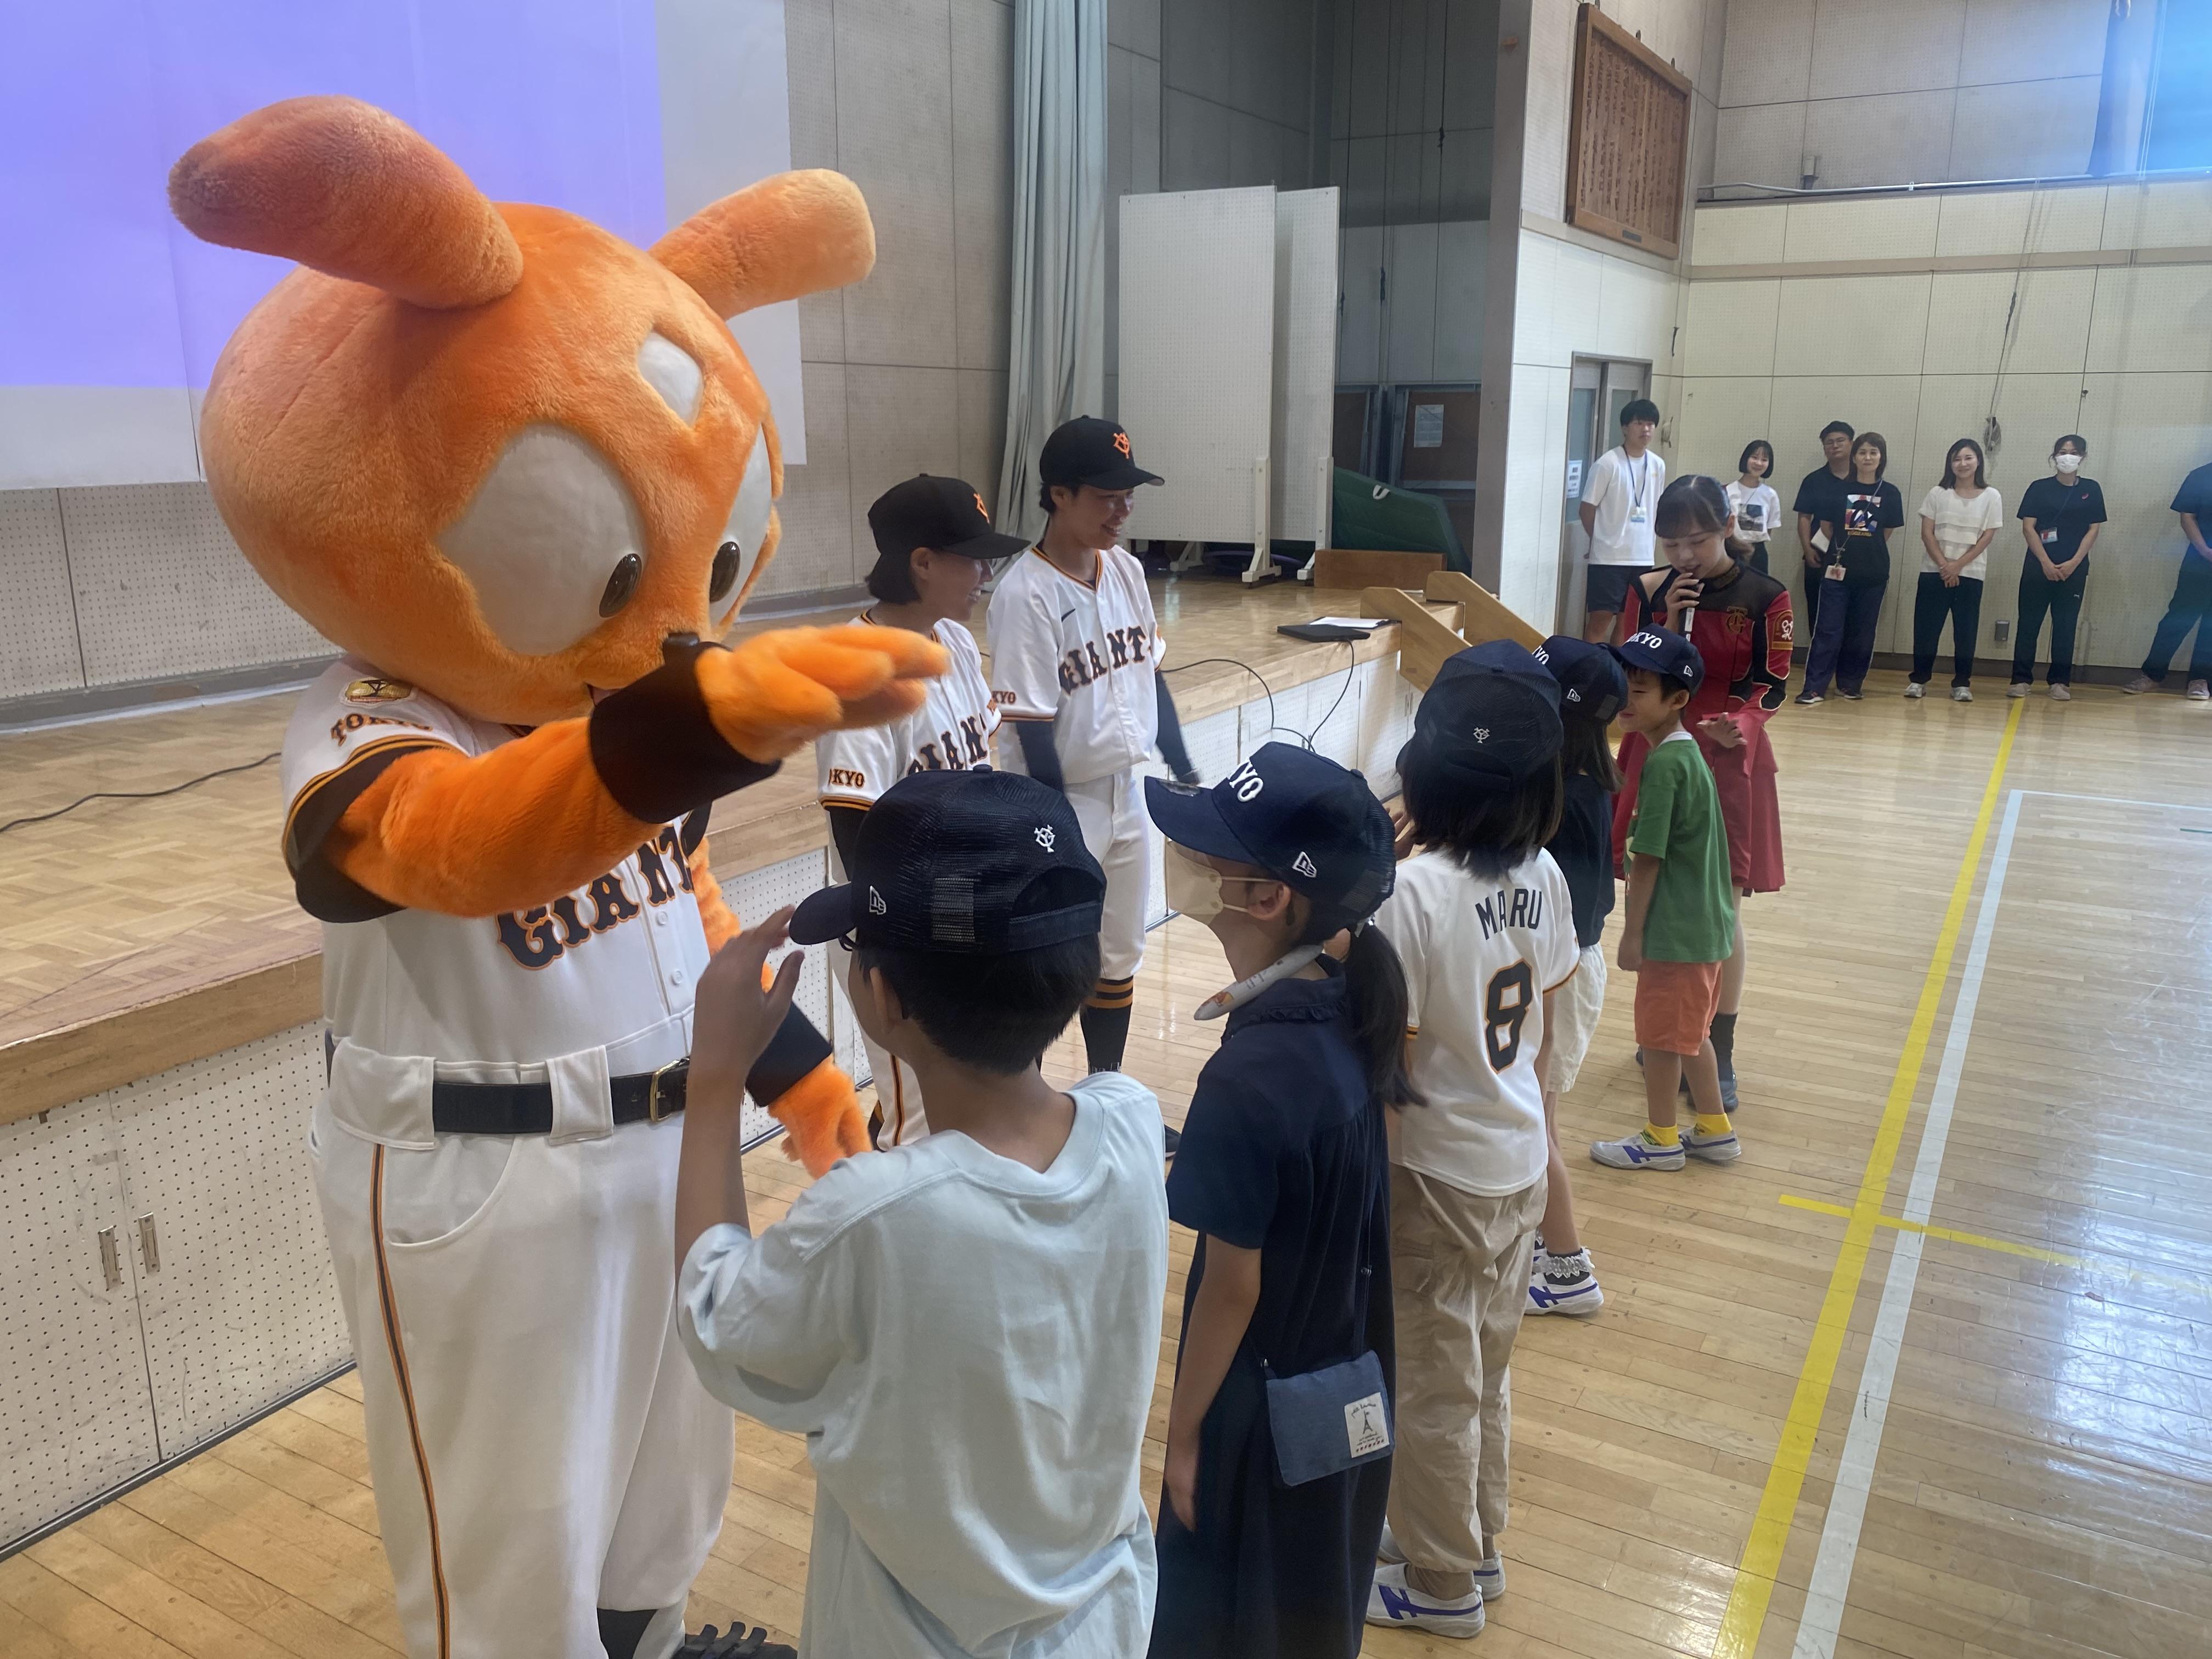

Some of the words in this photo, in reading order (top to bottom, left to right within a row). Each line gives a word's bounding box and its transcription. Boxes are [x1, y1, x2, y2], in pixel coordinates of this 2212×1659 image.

[1059, 625, 1152, 695] GIANT
[828, 769, 865, 788] KYO
[1475, 888, 1542, 940] MARU
[1485, 958, 1533, 1074] 8
